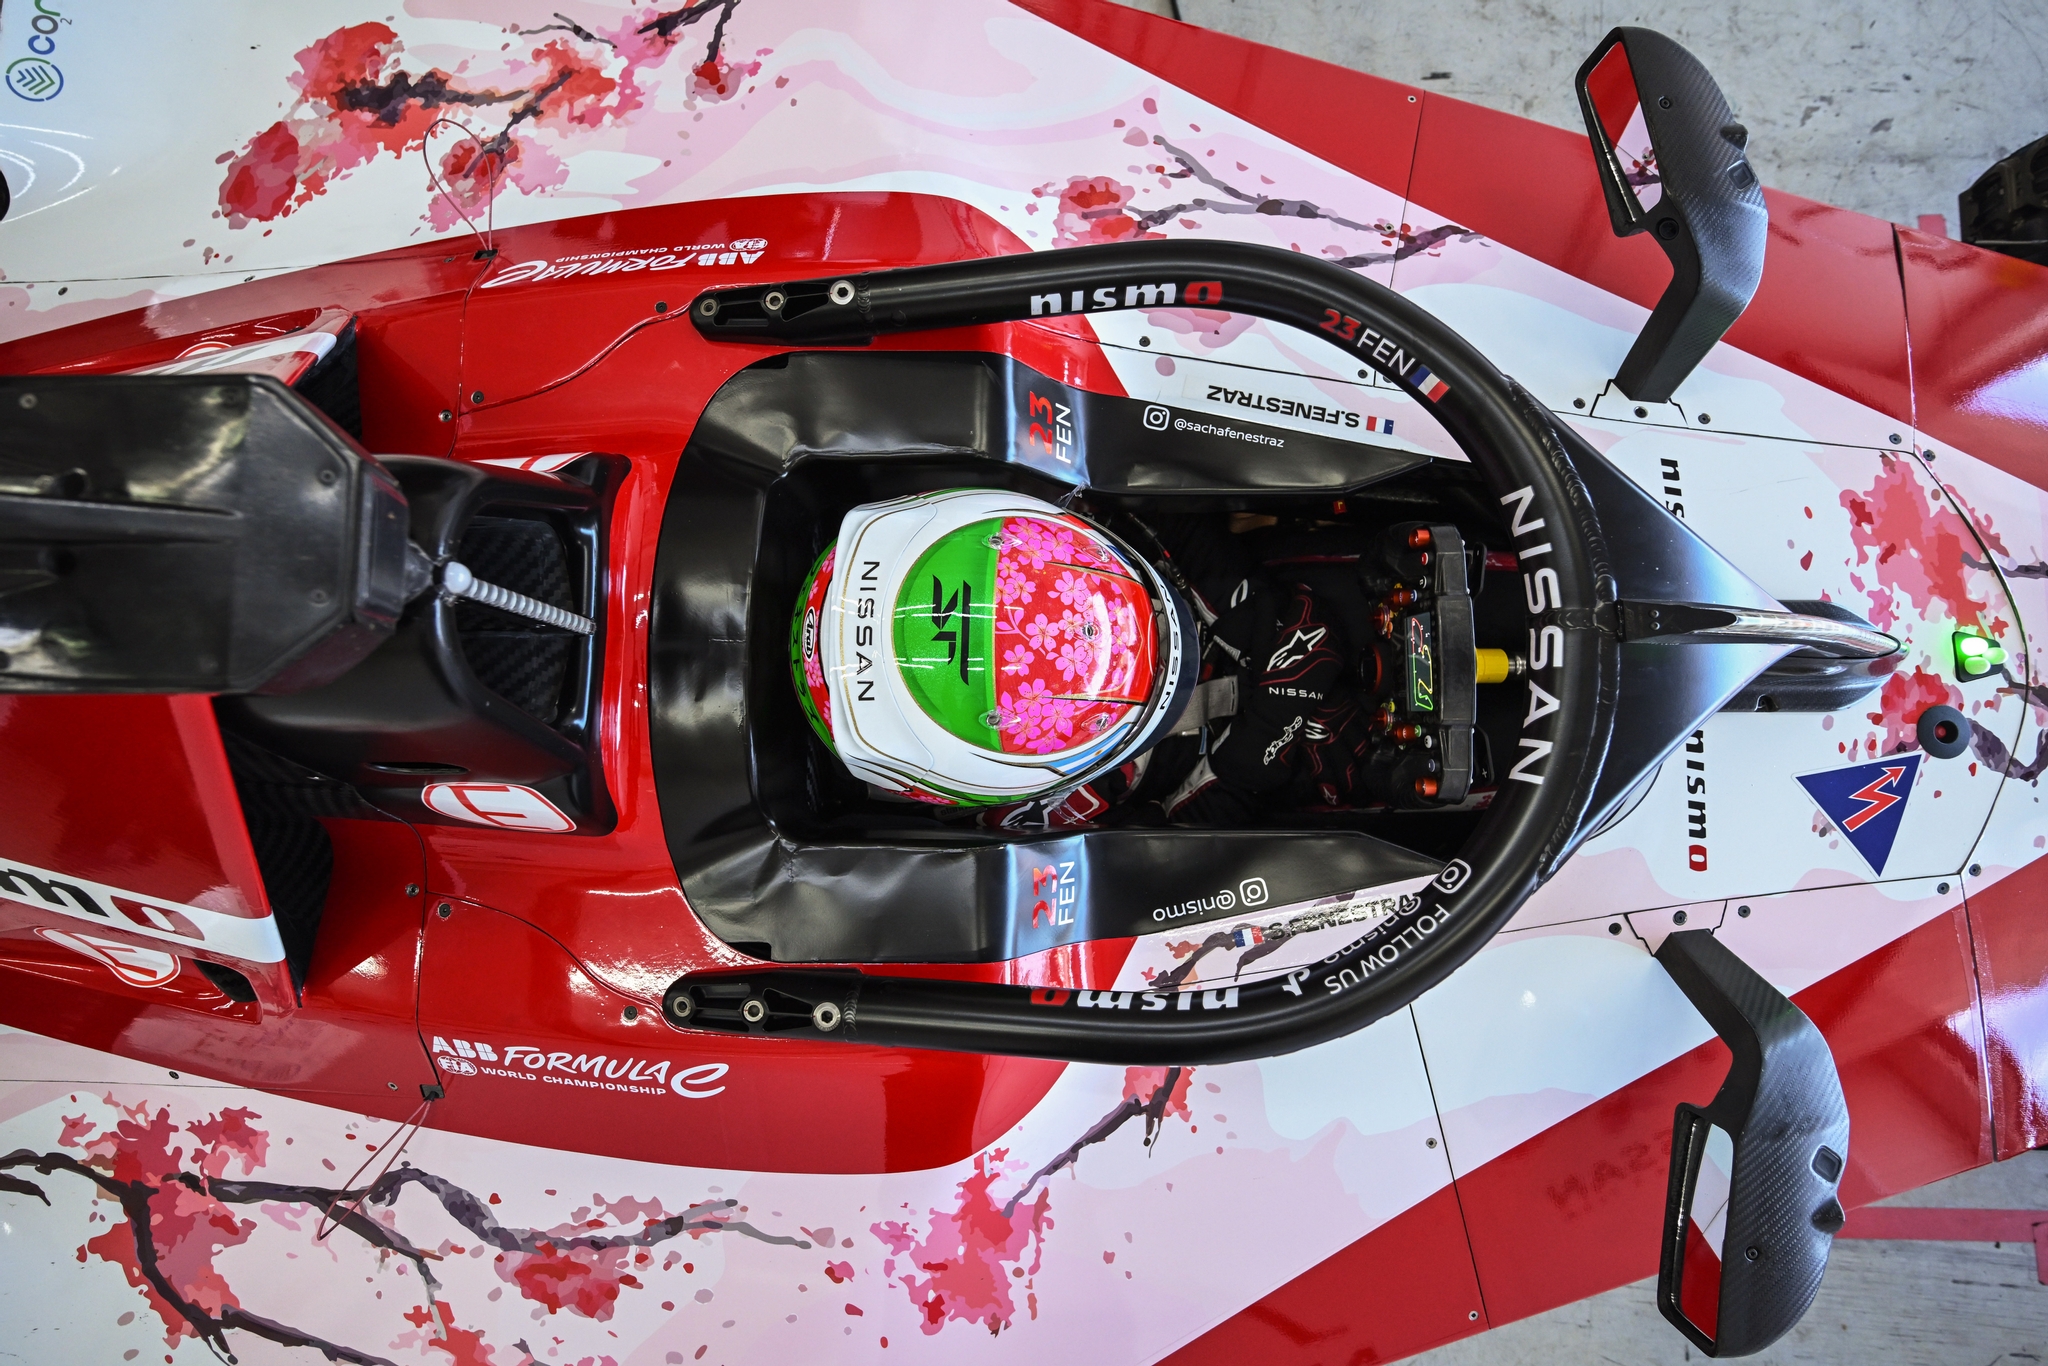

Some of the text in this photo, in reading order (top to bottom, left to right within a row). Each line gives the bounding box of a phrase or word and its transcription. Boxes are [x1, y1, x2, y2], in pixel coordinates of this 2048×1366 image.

[531, 252, 697, 282] FORMULA
[555, 246, 668, 264] CHAMPIONSHIP
[673, 242, 726, 253] WORLD
[696, 250, 765, 266] ABB
[1030, 281, 1223, 315] nismo
[1318, 308, 1416, 377] 23 FEN
[1030, 390, 1054, 455] 23
[1206, 384, 1361, 428] S.FENESTRAZ
[1055, 402, 1073, 465] FEN
[1174, 418, 1285, 448] @sachafenestraz
[1660, 457, 1685, 518] nis
[856, 560, 880, 702] NISSAN
[1159, 584, 1180, 711] NISSAN
[1501, 486, 1561, 785] NISSAN
[1268, 686, 1324, 701] NISSAN
[1685, 729, 1708, 872] nismo
[1032, 864, 1058, 930] 23
[1057, 860, 1075, 926] FEN
[1152, 891, 1236, 922] @nismo
[1267, 892, 1421, 940] S.FENESTRA
[1324, 903, 1451, 995] FOLLOW US
[432, 1036, 499, 1063] ABB
[503, 1044, 671, 1085] FORMULA
[439, 1057, 667, 1096] FIA WORLD CHAMPIONSHIP
